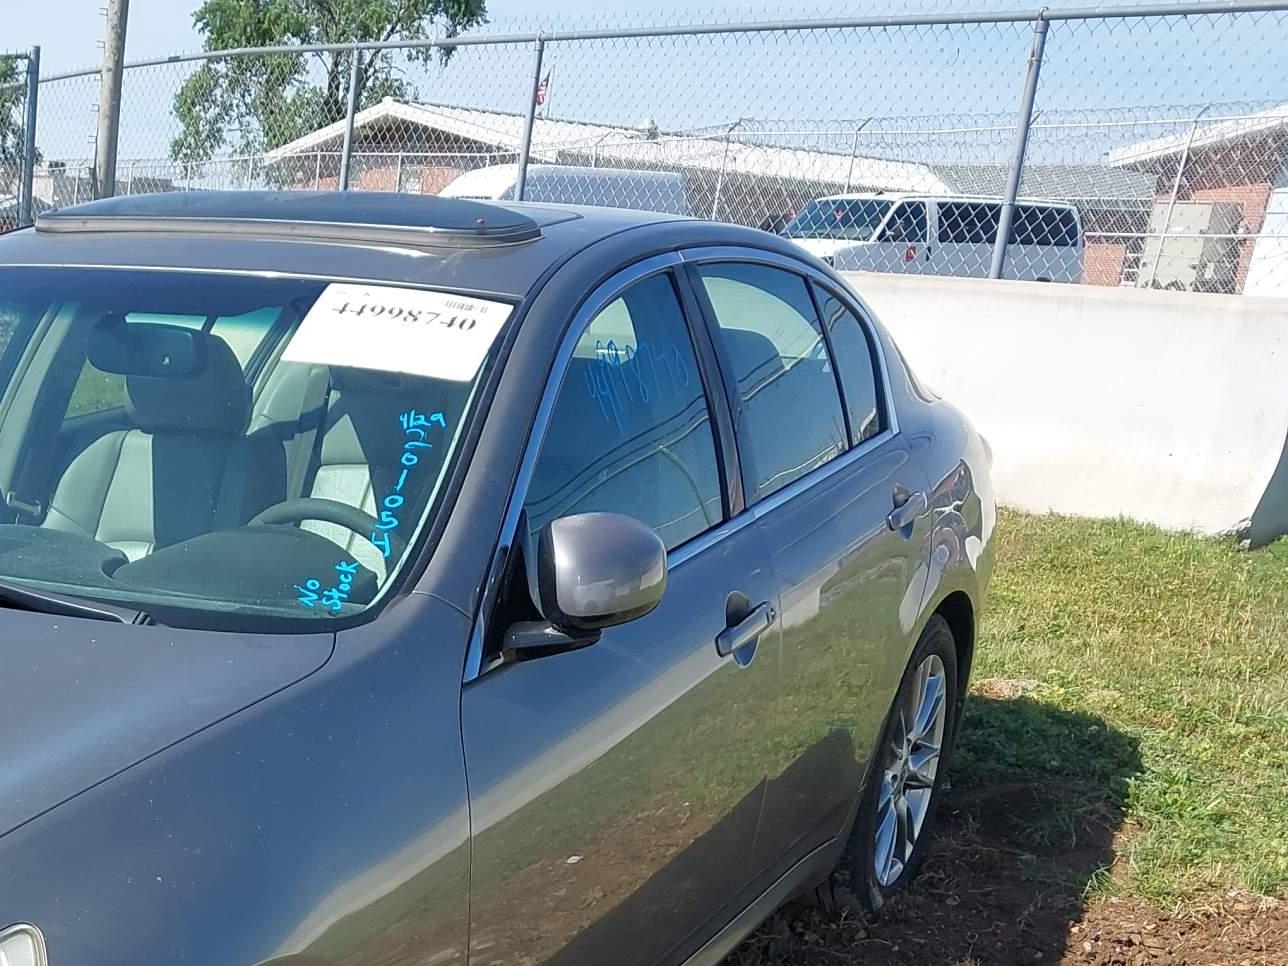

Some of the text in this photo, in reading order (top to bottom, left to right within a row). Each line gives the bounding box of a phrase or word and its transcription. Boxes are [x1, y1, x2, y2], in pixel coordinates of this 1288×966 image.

[331, 302, 477, 331] 44998740
[297, 576, 321, 608] No
[322, 560, 360, 614] Stock
